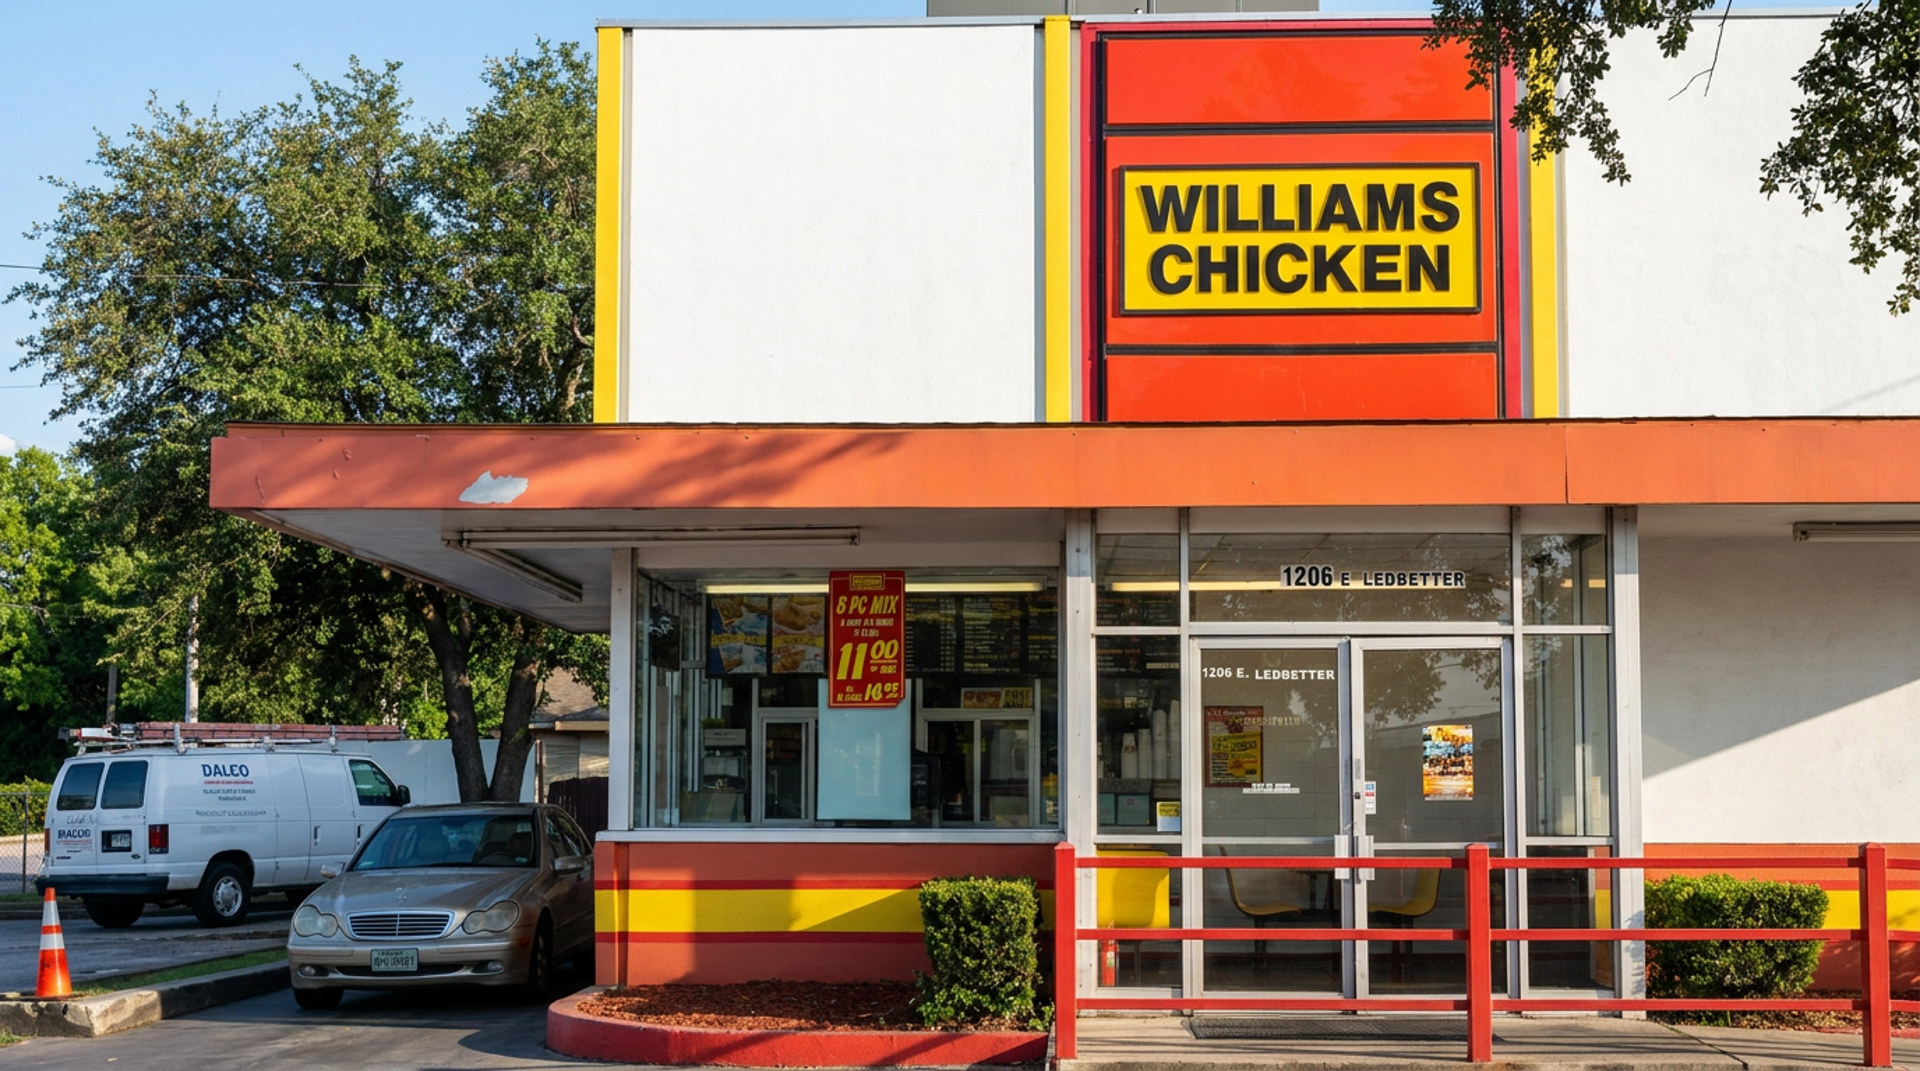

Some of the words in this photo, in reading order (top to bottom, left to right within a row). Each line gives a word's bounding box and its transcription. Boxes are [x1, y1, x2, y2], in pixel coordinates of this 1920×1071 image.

[1138, 181, 1461, 233] WILLIAMS
[1149, 243, 1450, 294] CHICKEN
[1282, 566, 1333, 587] 1206
[1340, 572, 1351, 587] E
[1363, 572, 1465, 587] LEDBETTER
[848, 595, 869, 615] PC
[869, 595, 899, 615] MIX
[1202, 667, 1233, 678] 1206
[1236, 667, 1250, 678] E.
